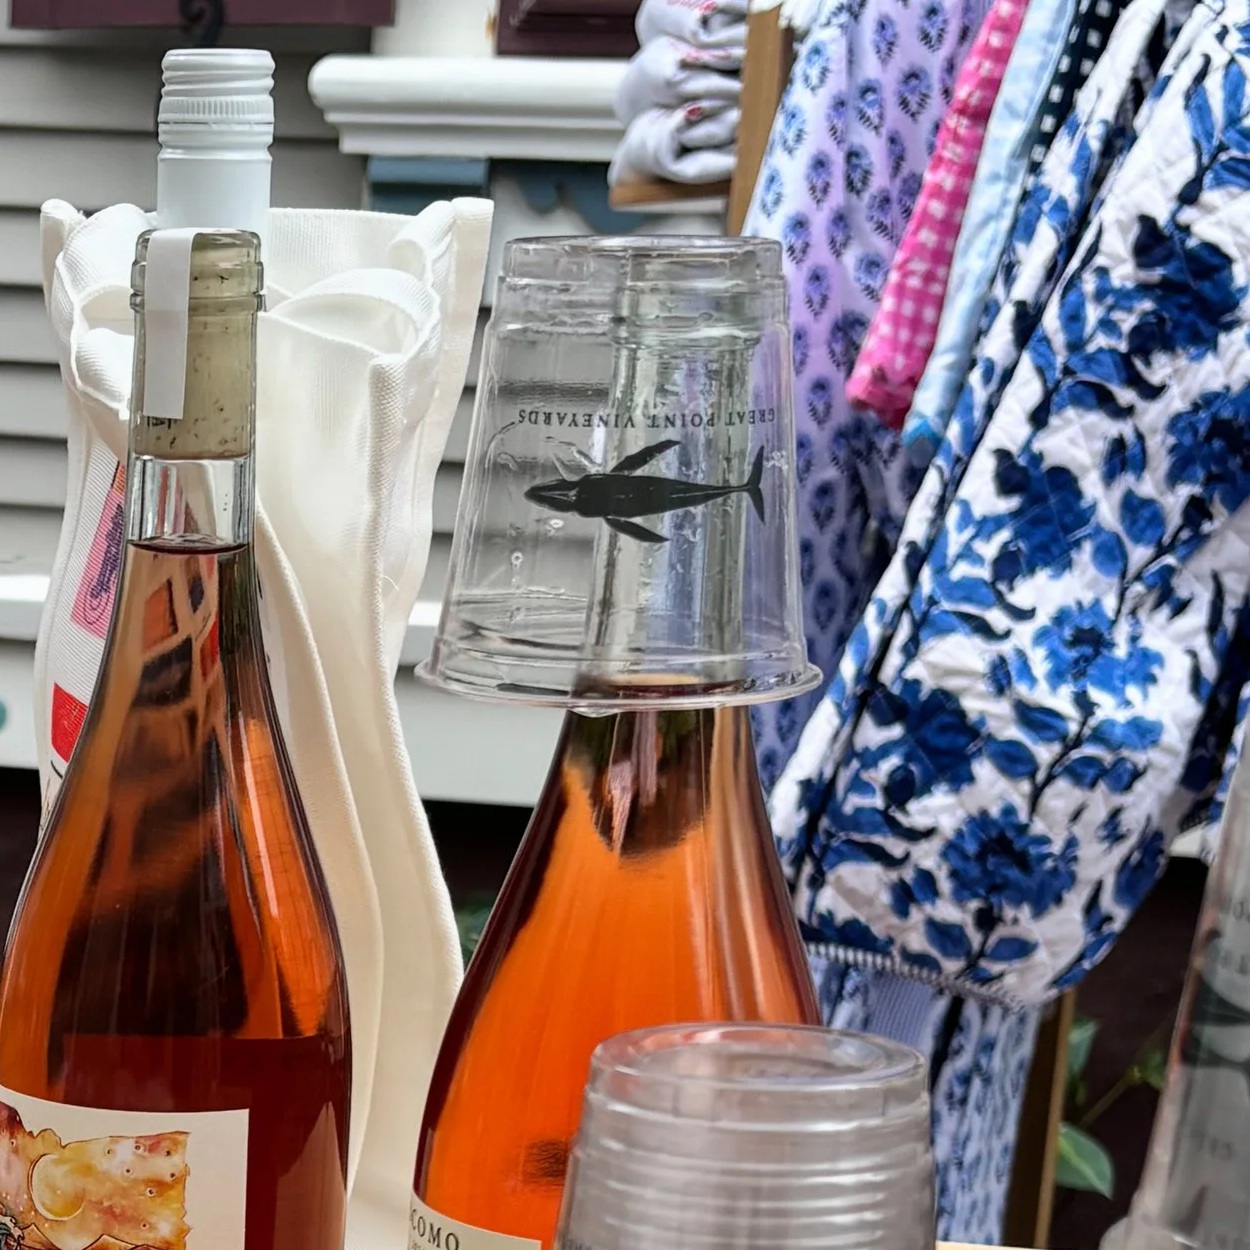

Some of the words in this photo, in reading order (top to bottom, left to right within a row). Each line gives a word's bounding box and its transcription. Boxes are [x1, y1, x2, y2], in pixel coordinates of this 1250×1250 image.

[517, 408, 636, 429] VINEYARDS
[647, 411, 716, 429] POINT
[725, 408, 776, 427] GREAT
